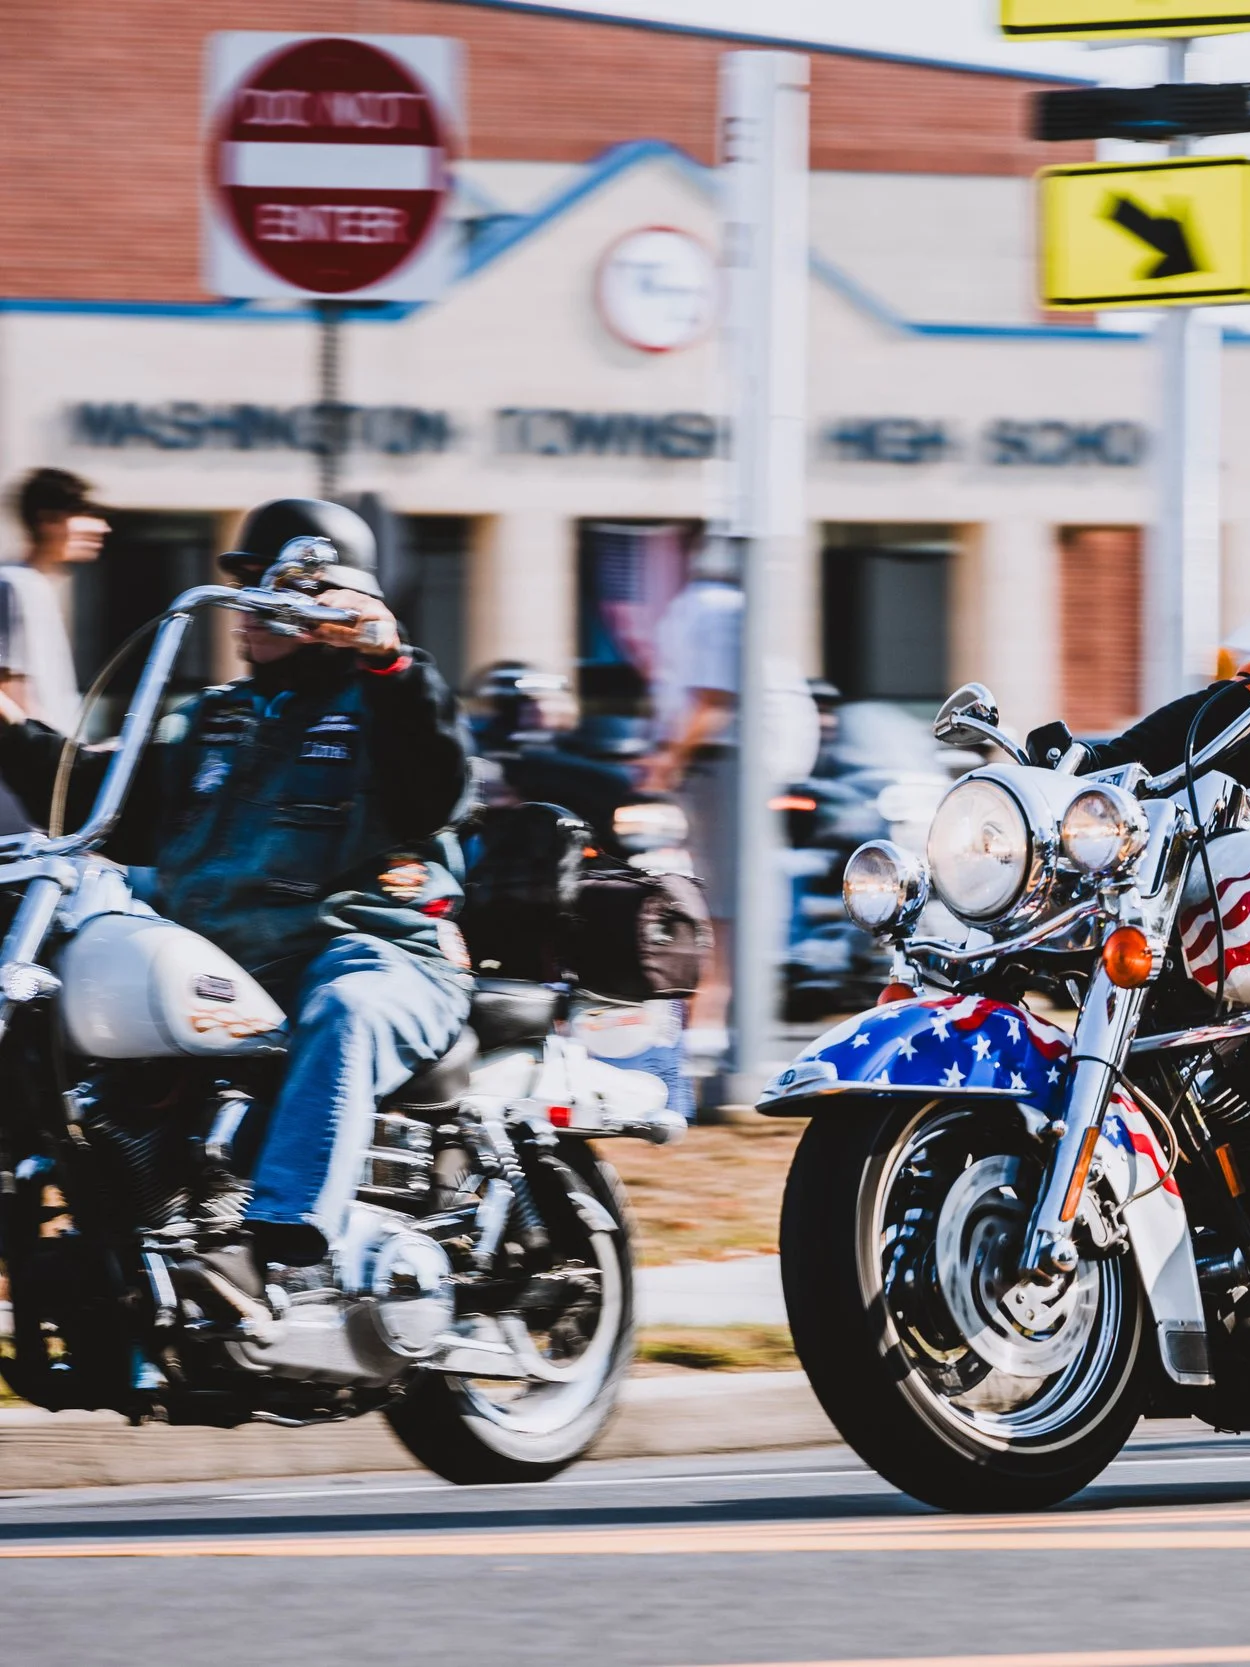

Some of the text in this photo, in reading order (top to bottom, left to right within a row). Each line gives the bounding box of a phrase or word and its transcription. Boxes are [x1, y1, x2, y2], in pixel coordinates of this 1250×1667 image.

[241, 87, 426, 129] DO NOT
[256, 202, 408, 243] ENTER
